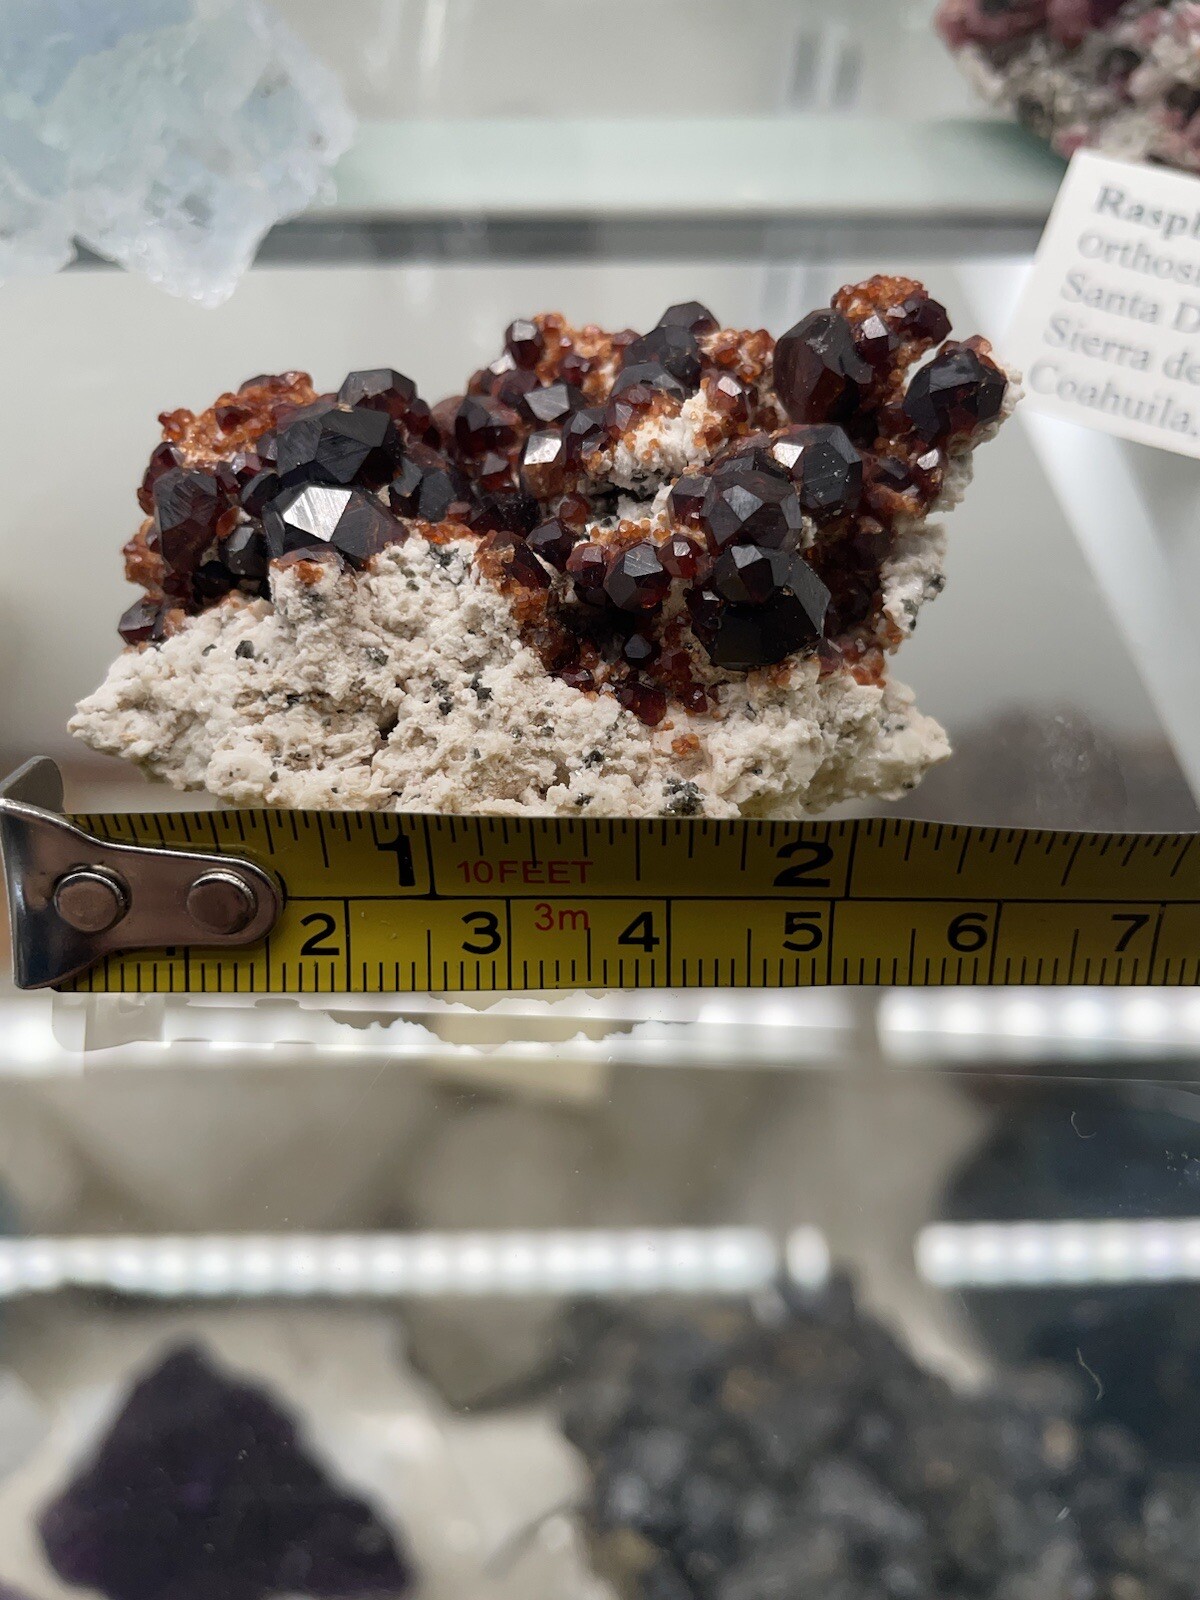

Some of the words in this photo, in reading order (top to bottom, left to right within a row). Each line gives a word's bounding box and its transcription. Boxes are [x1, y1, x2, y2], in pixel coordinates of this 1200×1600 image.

[1060, 267, 1159, 324] Santa
[1043, 311, 1150, 372] Sierra
[1162, 351, 1200, 386] de
[1028, 359, 1198, 437] Coahuila.
[376, 835, 415, 887] 1
[773, 841, 834, 888] 2
[300, 912, 340, 956] 2
[461, 911, 502, 955] 3
[617, 911, 660, 953] 4
[782, 911, 823, 952] 5
[947, 912, 988, 953] 6
[1110, 913, 1150, 952] 7
[534, 903, 589, 931] 3m
